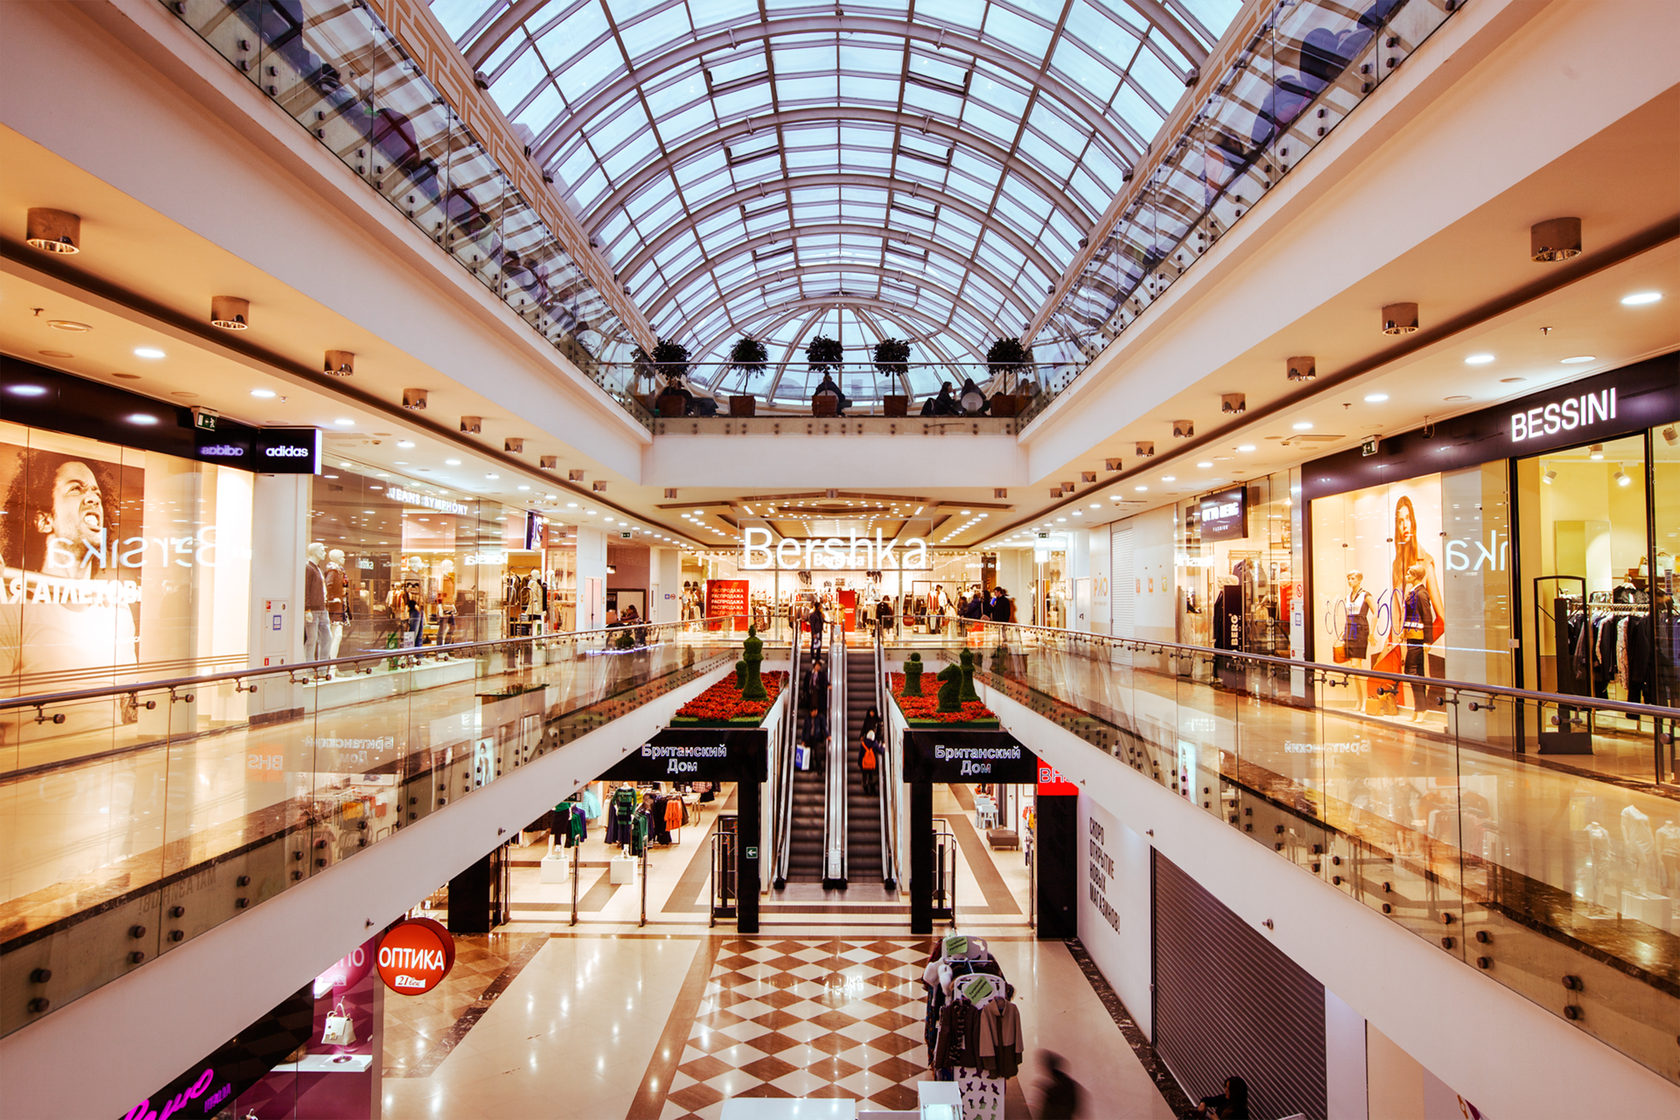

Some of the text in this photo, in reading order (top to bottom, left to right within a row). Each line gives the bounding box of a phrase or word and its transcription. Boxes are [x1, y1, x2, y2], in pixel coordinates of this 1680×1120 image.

[1511, 387, 1616, 443] BESSINI
[266, 446, 308, 458] adidas
[744, 527, 927, 570] Bershka
[1230, 615, 1239, 646] BERG
[641, 743, 727, 760] Британский
[934, 745, 1020, 761] Британский
[667, 758, 698, 774] Дом
[960, 760, 991, 776] Дом
[1039, 768, 1070, 783] BH
[379, 947, 445, 971] ОПТИКА
